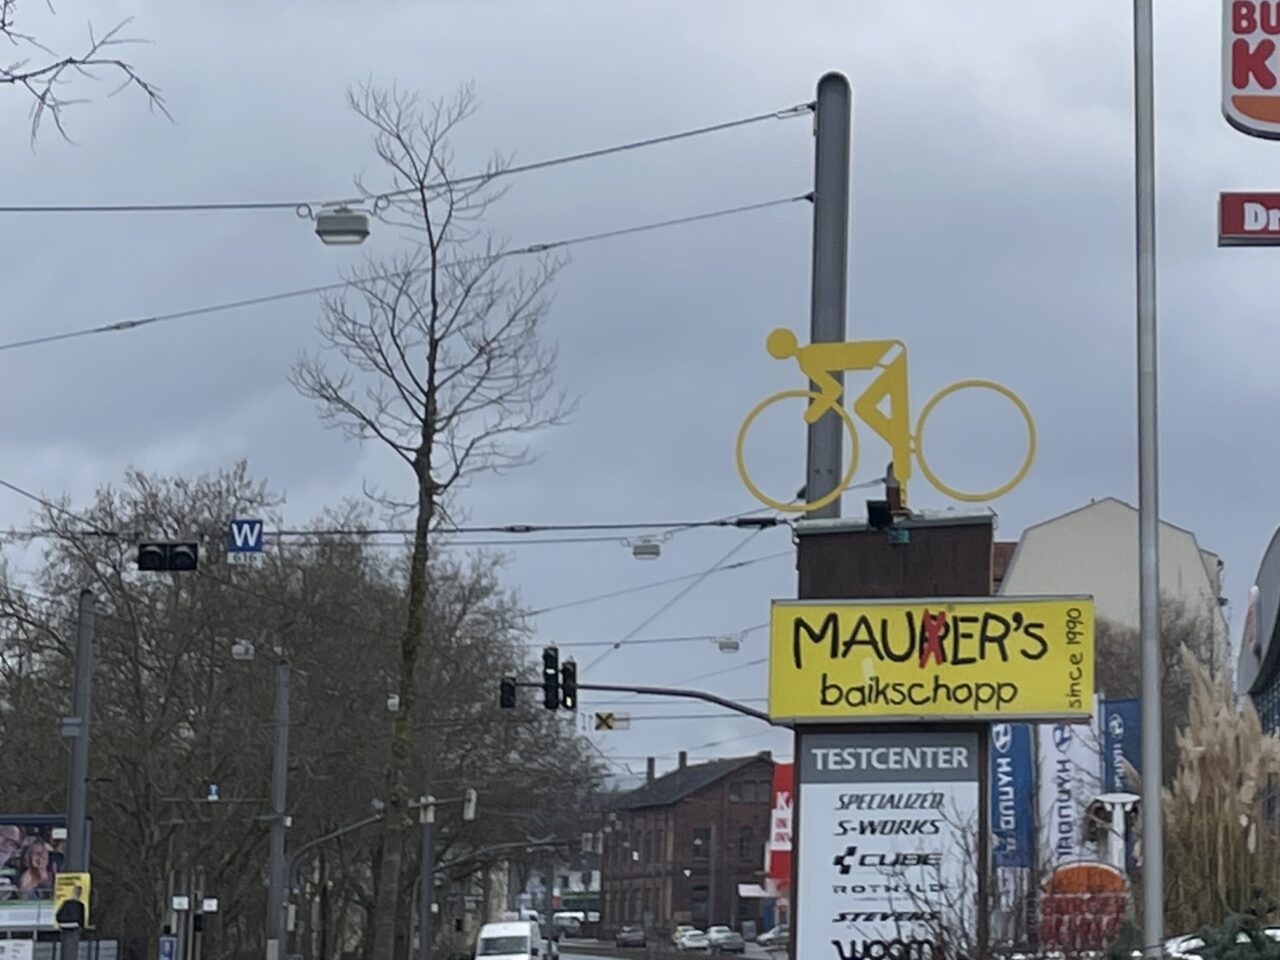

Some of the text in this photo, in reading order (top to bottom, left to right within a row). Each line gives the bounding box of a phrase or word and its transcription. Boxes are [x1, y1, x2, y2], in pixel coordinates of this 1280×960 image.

[232, 523, 260, 547] W
[1064, 607, 1084, 709] since 1990
[820, 673, 1018, 711] baikschopp
[811, 747, 968, 771] TESTCENTER
[833, 792, 945, 811] SPECIALIZED
[834, 819, 944, 836] S-WORKS
[858, 853, 944, 867] CUBE
